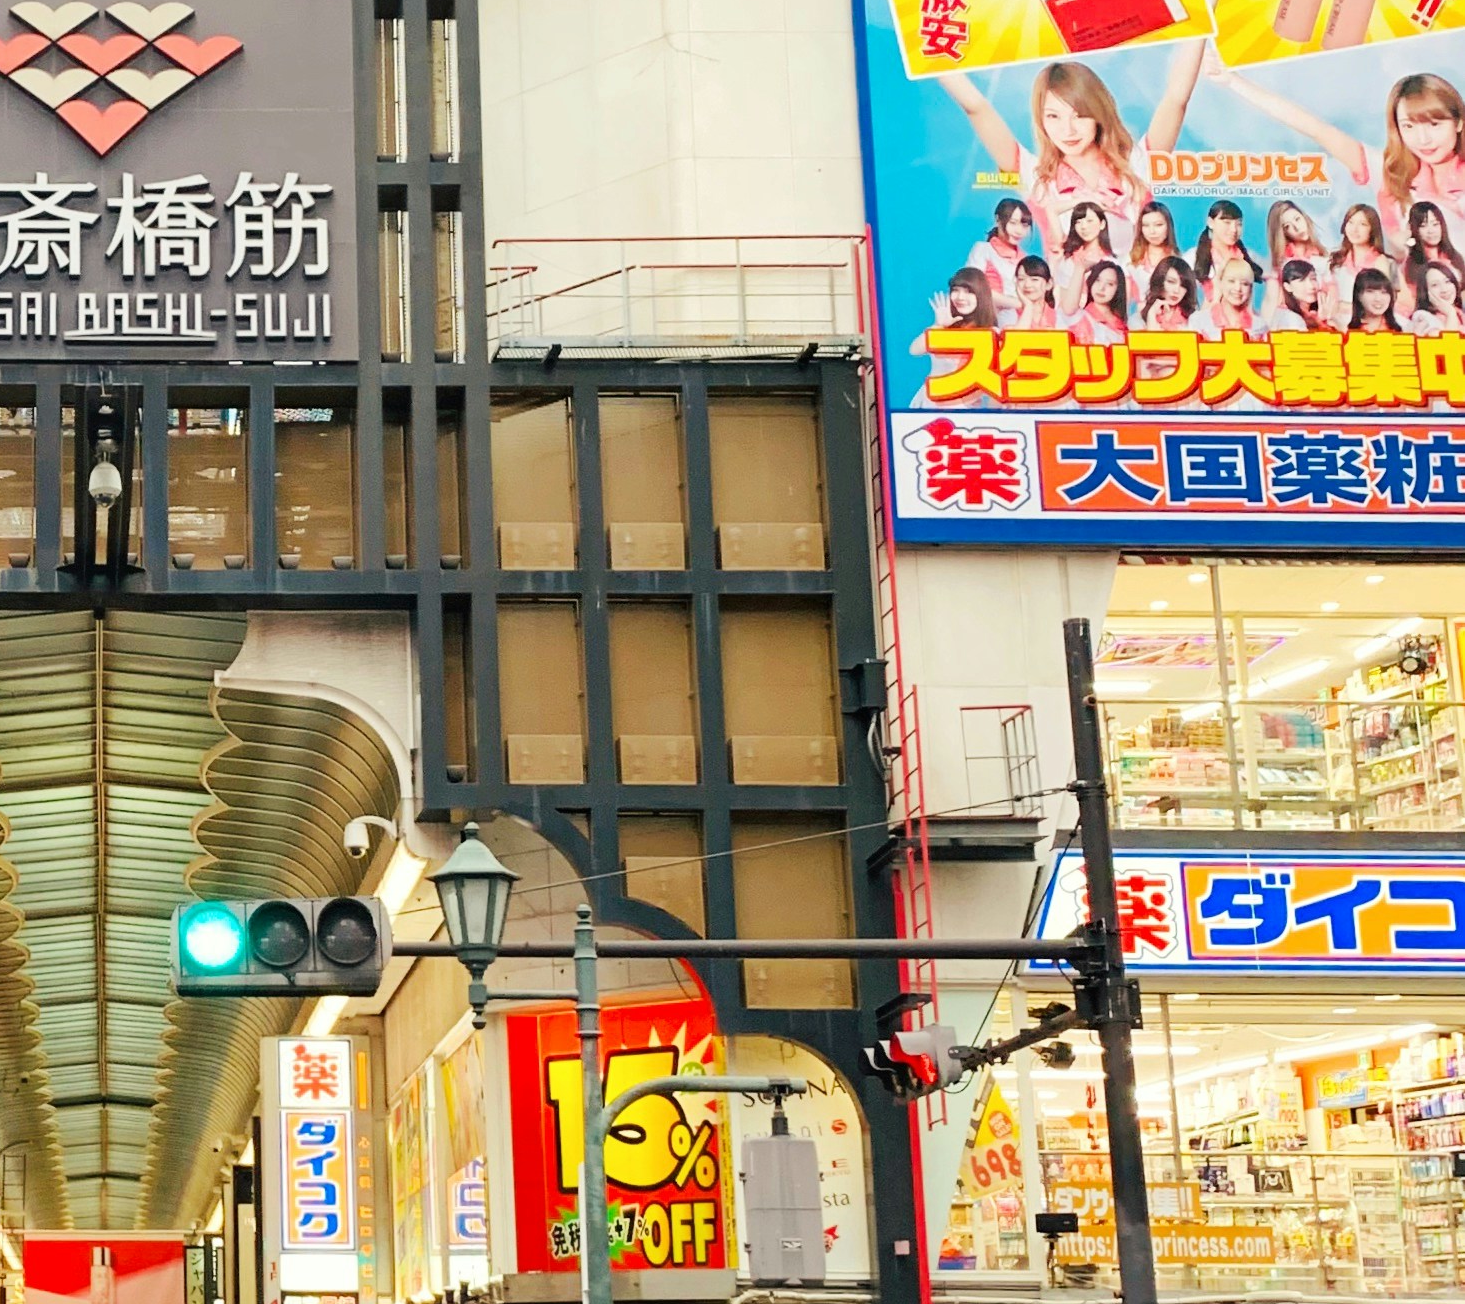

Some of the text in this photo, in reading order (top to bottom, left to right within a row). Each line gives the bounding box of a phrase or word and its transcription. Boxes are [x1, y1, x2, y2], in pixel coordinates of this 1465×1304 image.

[1149, 153, 1330, 185] DDプリンセス
[1152, 186, 1202, 197] DAIKOKU
[1204, 186, 1234, 197] DRUG
[1306, 187, 1331, 197] UNIT
[923, 417, 1023, 509] 薬
[1058, 430, 1465, 508] 大国薬粧
[292, 1043, 340, 1100] 薬
[295, 1117, 340, 1240] ダイコク
[642, 1202, 716, 1266] OFF
